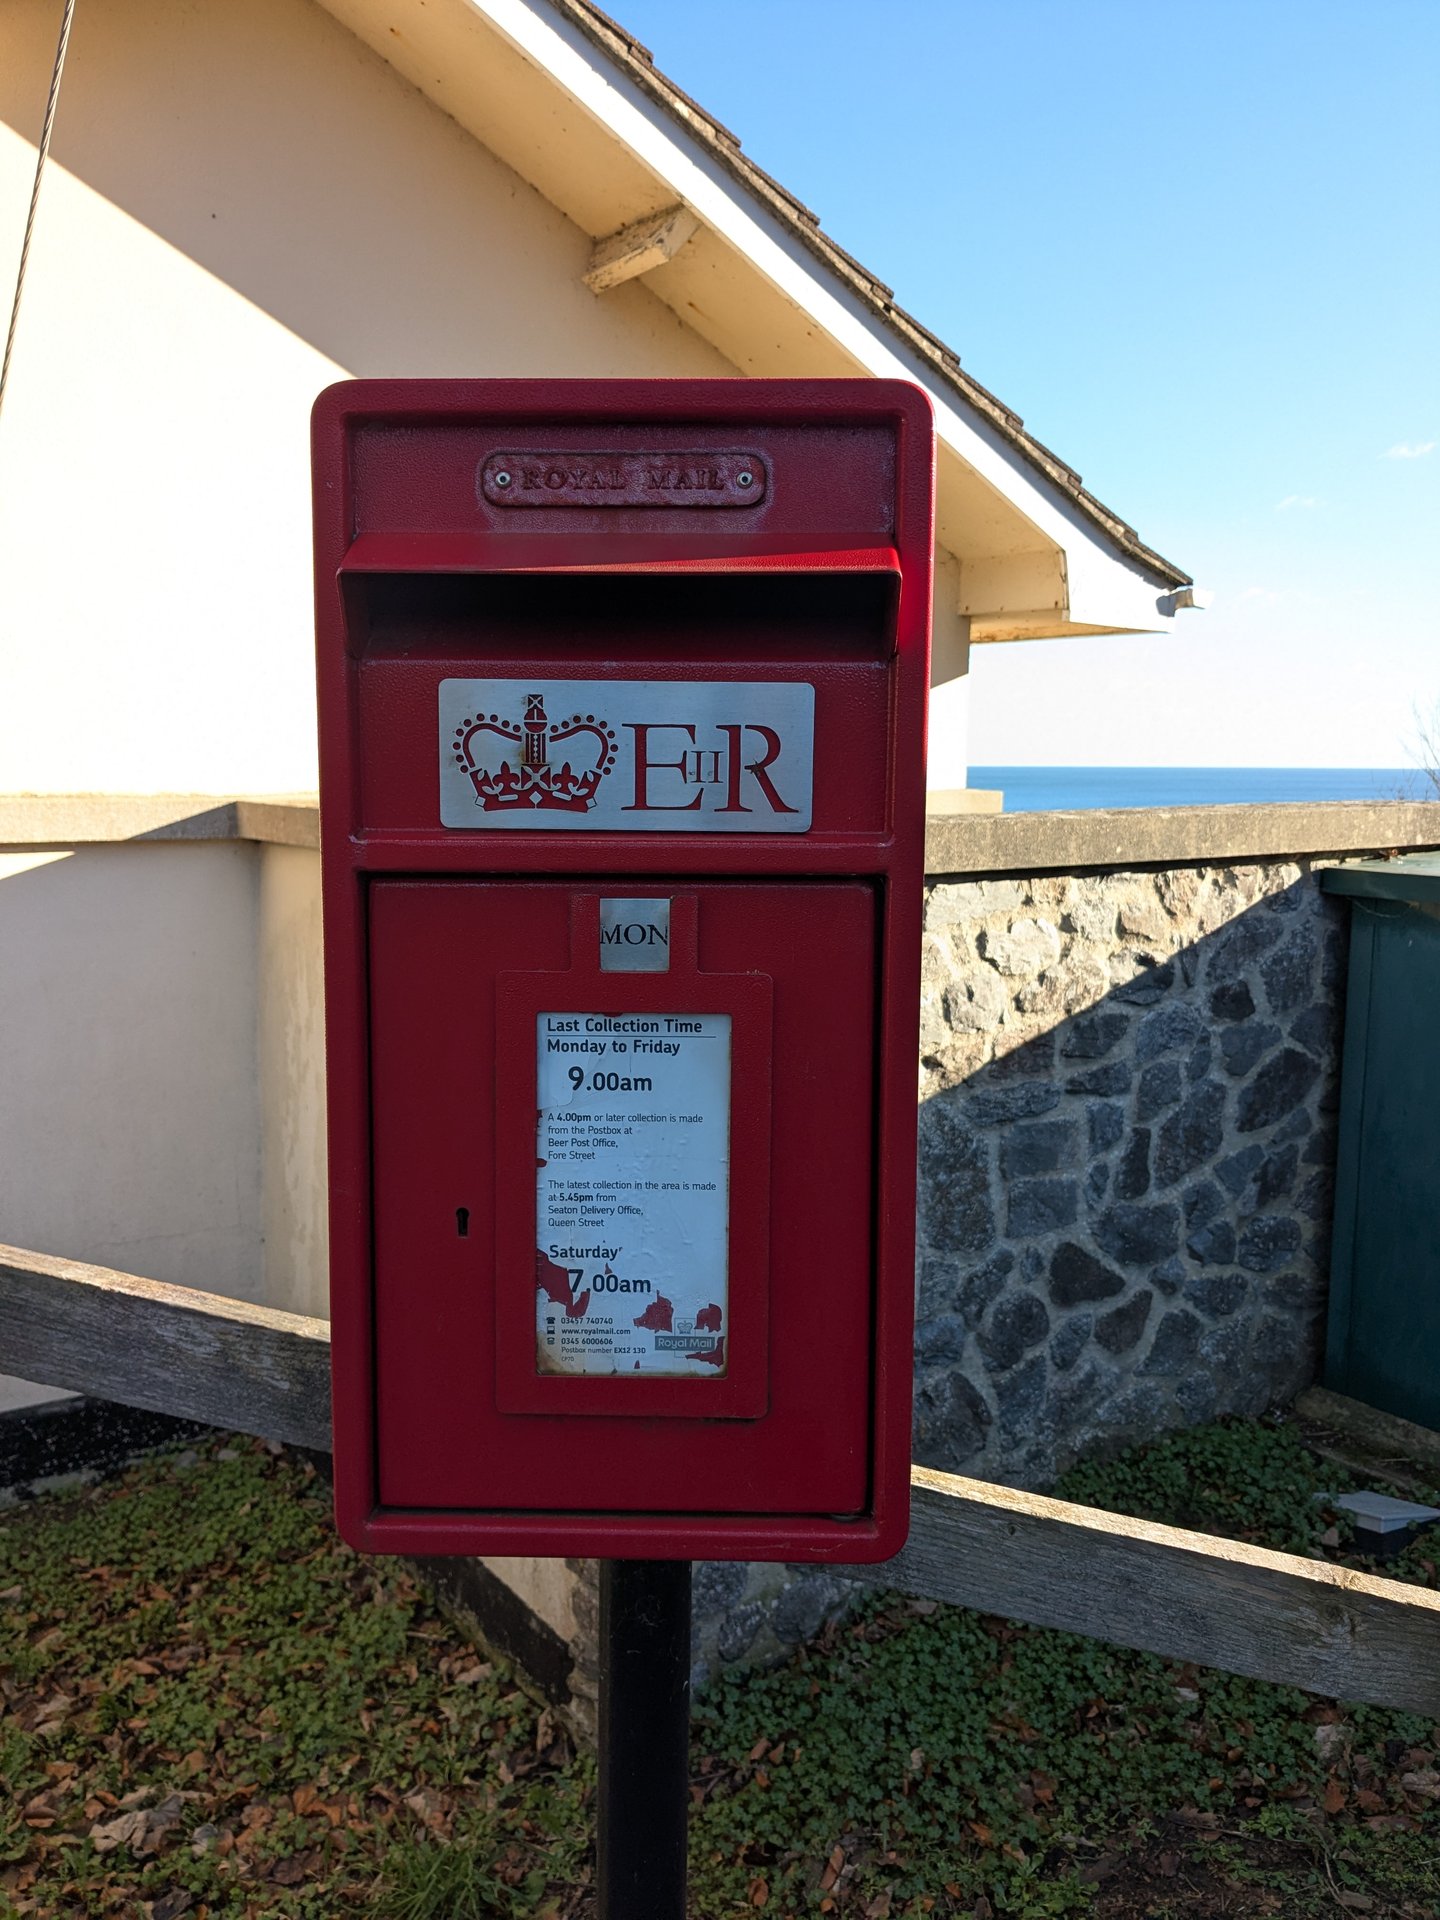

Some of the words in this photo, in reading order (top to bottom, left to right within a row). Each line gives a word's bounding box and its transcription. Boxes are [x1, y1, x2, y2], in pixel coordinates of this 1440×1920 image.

[522, 469, 626, 490] ROYAL
[648, 469, 725, 490] MAIL
[600, 923, 668, 946] MON
[547, 1018, 580, 1032] Last
[585, 1019, 659, 1033] Collection
[664, 1019, 702, 1033] Time
[547, 1039, 606, 1055] Monday
[612, 1040, 626, 1053] to
[633, 1040, 680, 1056] Friday
[568, 1066, 652, 1091] 9.00am
[548, 1113, 554, 1121] A
[557, 1113, 591, 1123] 4.00pm
[606, 1113, 625, 1122] later
[628, 1114, 667, 1122] collection
[670, 1114, 676, 1122] is
[679, 1115, 703, 1123] made
[548, 1126, 568, 1134] from
[571, 1126, 585, 1134] the
[588, 1126, 621, 1135] Postbox
[549, 1138, 568, 1147] Beer
[571, 1138, 589, 1147] Post
[593, 1138, 618, 1148] Office,
[548, 1151, 566, 1159] Fore
[569, 1151, 595, 1160] Street
[548, 1180, 564, 1189] The
[567, 1181, 590, 1189] latest
[593, 1181, 632, 1189] collection
[635, 1181, 642, 1189] in
[645, 1181, 658, 1190] the
[683, 1182, 689, 1190] is
[692, 1182, 716, 1190] made
[559, 1193, 593, 1203] 5.45pm
[596, 1193, 616, 1201] from
[548, 1206, 578, 1214] Seaton
[581, 1206, 615, 1216] Delivery
[618, 1206, 644, 1216] Office,
[548, 1218, 575, 1227] Queen
[579, 1218, 604, 1227] Street
[550, 1245, 618, 1261] Saturday
[568, 1269, 651, 1292] 7.00am
[561, 1317, 583, 1325] 03457
[586, 1317, 613, 1325] 740740
[658, 1338, 687, 1349] Royal
[689, 1338, 712, 1348] Mail
